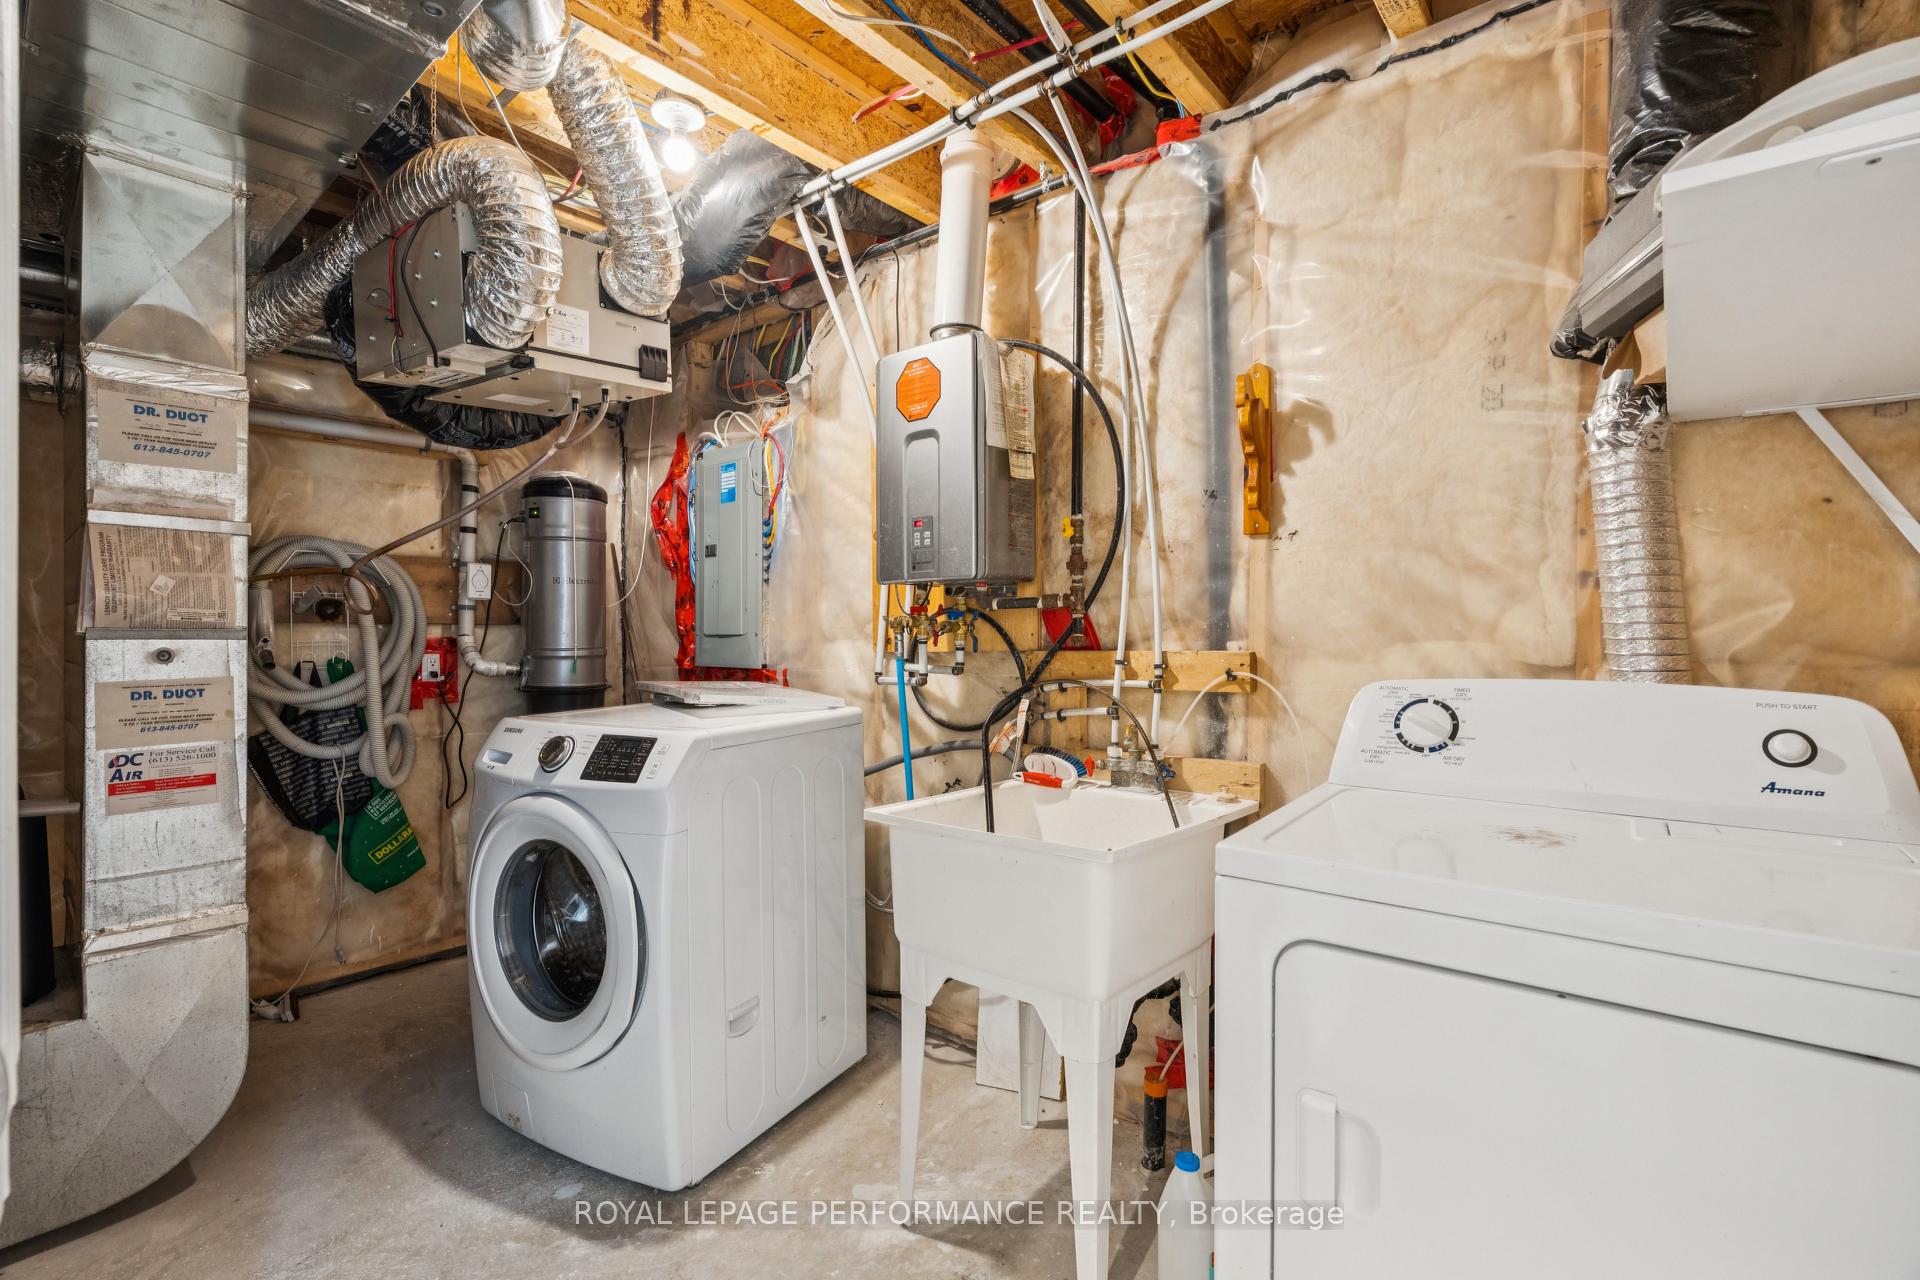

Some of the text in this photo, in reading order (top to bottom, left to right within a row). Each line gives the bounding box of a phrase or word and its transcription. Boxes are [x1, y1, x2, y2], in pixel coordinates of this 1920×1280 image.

[133, 404, 161, 417] DR.
[166, 408, 208, 423] DUCT
[133, 443, 211, 459] 613-845-0707
[130, 690, 157, 701] DR.
[1792, 703, 1817, 711] START
[140, 723, 199, 733] 613-845-0707
[166, 747, 197, 756] Service
[115, 752, 144, 768] DC
[148, 752, 216, 764] (613) 526-1000
[1760, 781, 1826, 797] Amana
